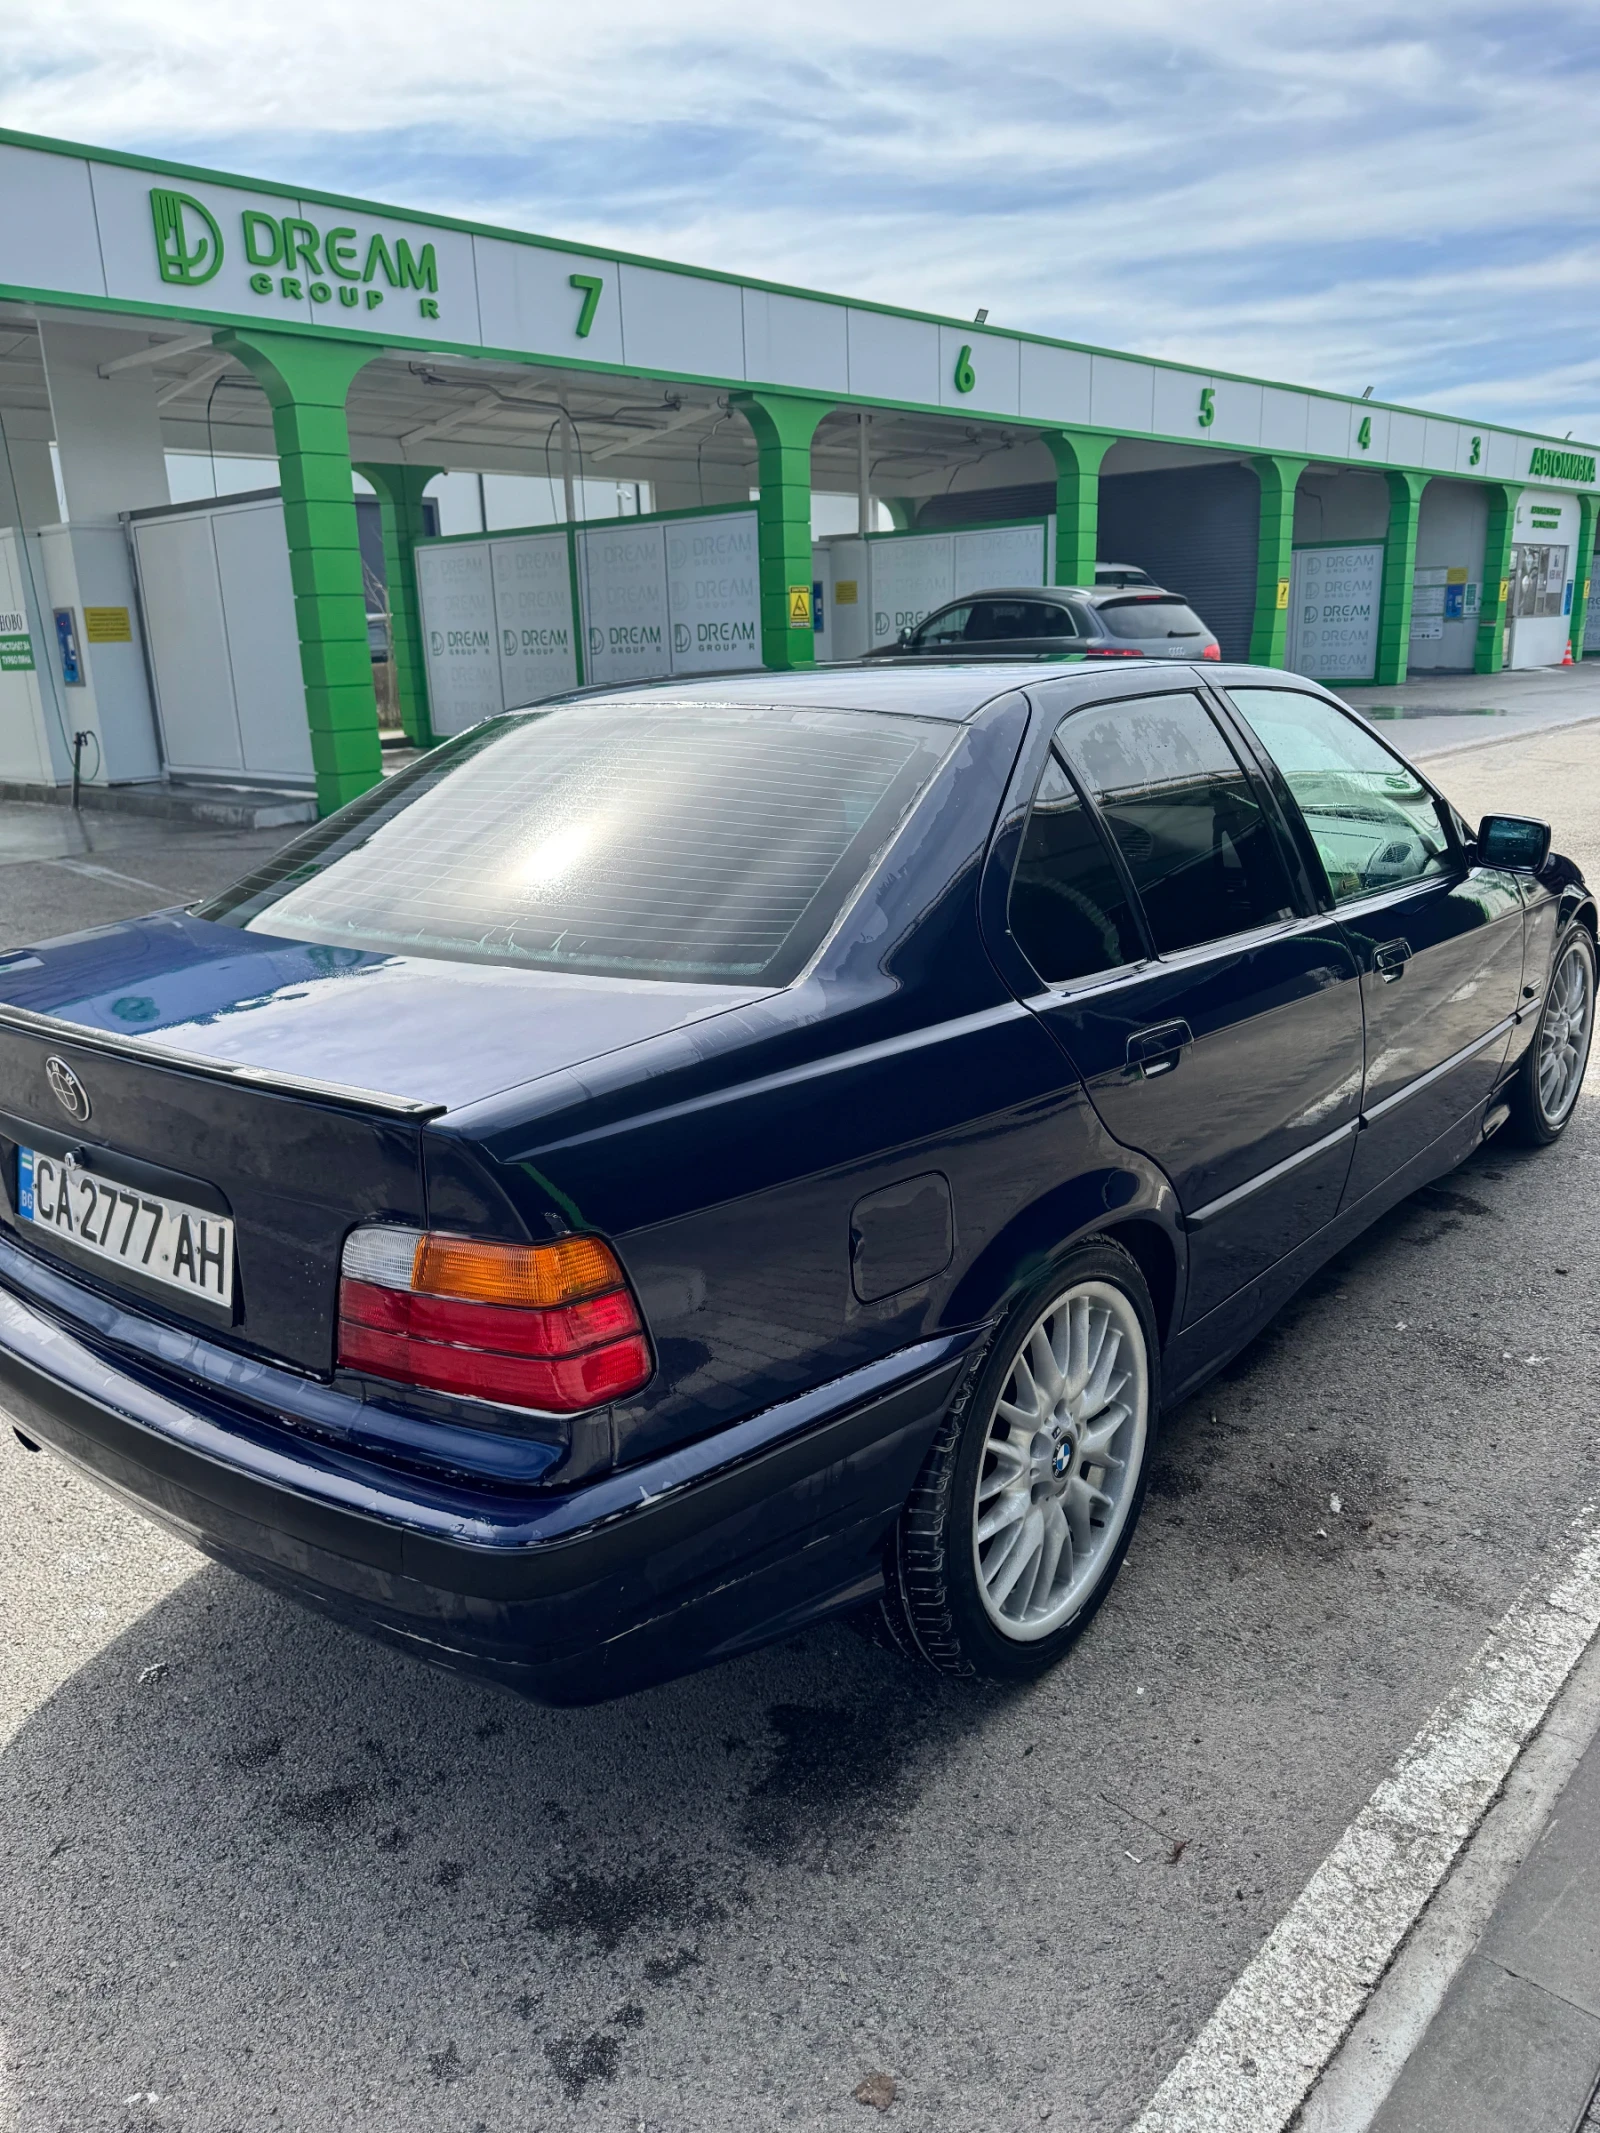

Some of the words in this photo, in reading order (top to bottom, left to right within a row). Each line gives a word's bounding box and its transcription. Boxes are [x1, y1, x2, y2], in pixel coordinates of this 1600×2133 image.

[241, 209, 438, 293] DREAM
[250, 273, 384, 310] GROUP
[420, 298, 440, 319] R
[569, 273, 603, 338] 7
[954, 345, 975, 393] 6
[1198, 388, 1215, 427] 5
[1358, 417, 1371, 450] 4
[1470, 436, 1481, 465] 3
[1530, 447, 1596, 482] АВТОМИВКА
[693, 533, 750, 556] DREAM
[1326, 554, 1374, 568] DREAM
[695, 578, 753, 600] DREAM
[1325, 580, 1372, 592] DREAM
[1323, 605, 1370, 617] DREAM
[447, 631, 490, 647] DREAM
[522, 629, 568, 646] DREAM
[609, 626, 661, 644] DREAM
[697, 622, 755, 642] DREAM
[1321, 630, 1369, 641] DREAM
[699, 644, 737, 652] GROUP
[1320, 654, 1367, 665] DREAM
[21, 1189, 33, 1209] BG
[37, 1159, 74, 1232] CA
[80, 1178, 164, 1265] 2777
[173, 1214, 226, 1295] AH
